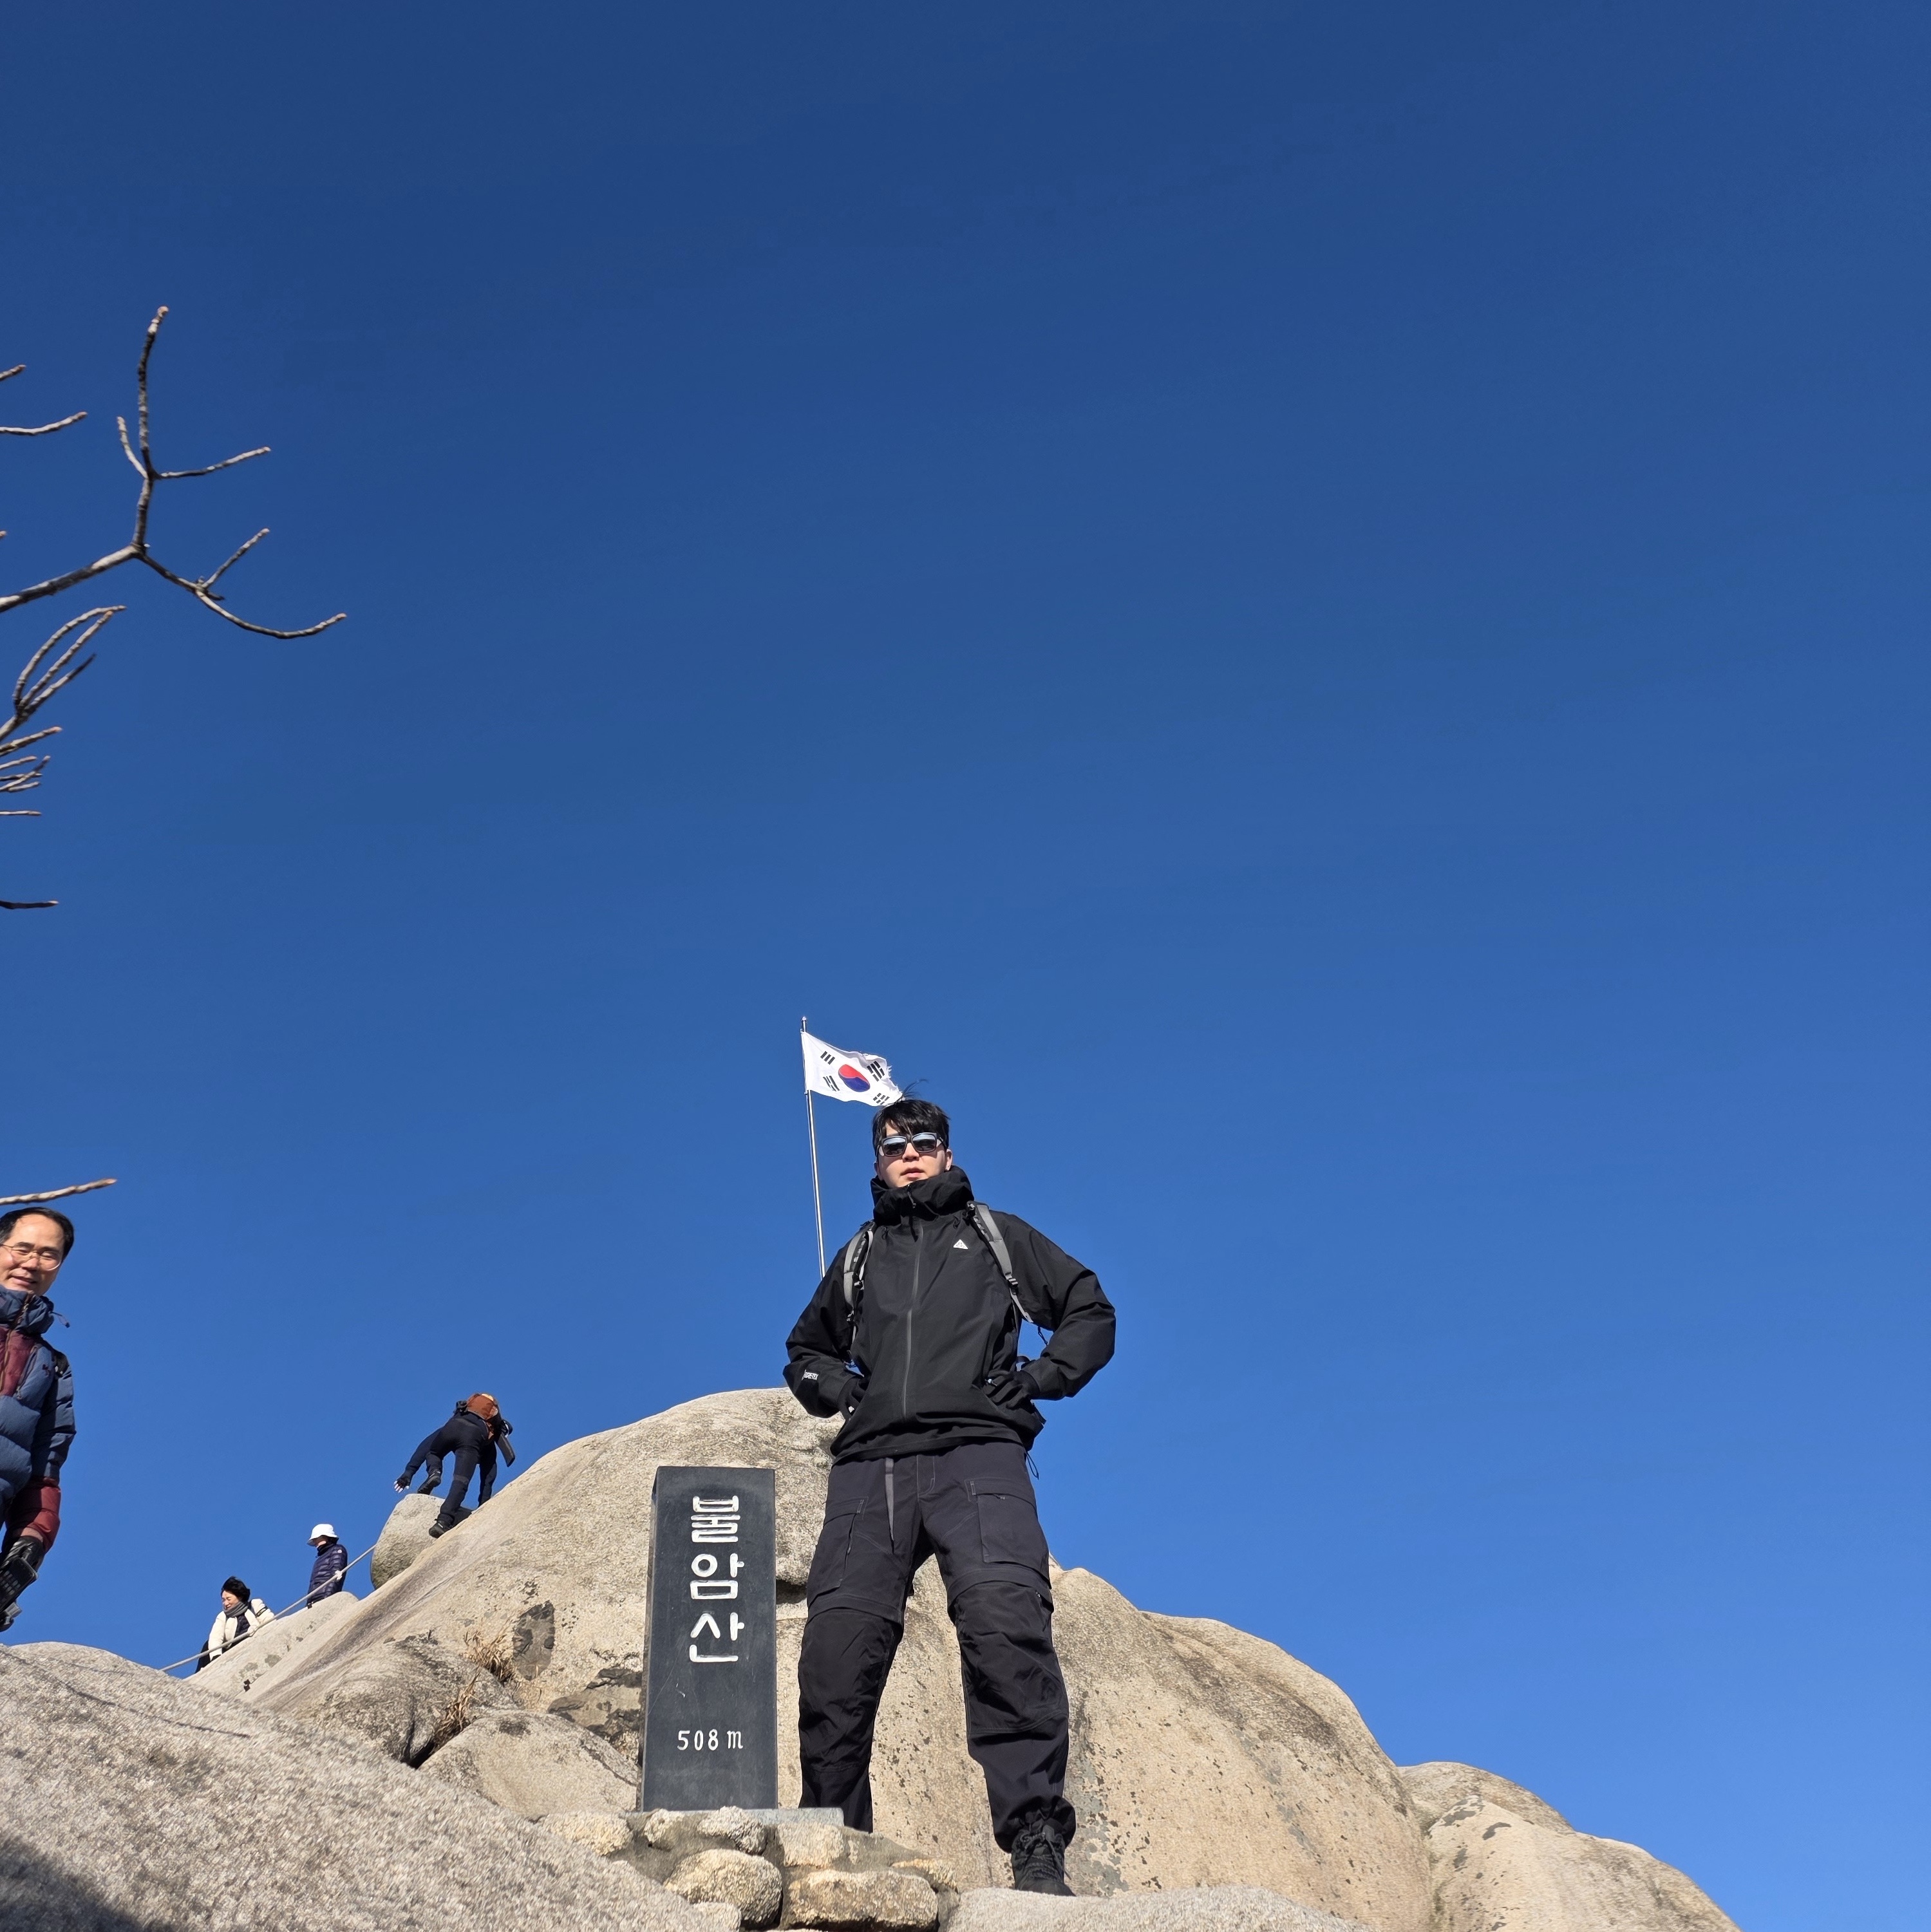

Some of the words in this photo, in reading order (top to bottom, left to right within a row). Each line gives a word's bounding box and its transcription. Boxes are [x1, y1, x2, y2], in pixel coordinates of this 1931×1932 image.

[689, 1495, 745, 1663] 불암산
[677, 1729, 719, 1751] 508
[726, 1730, 744, 1749] m
